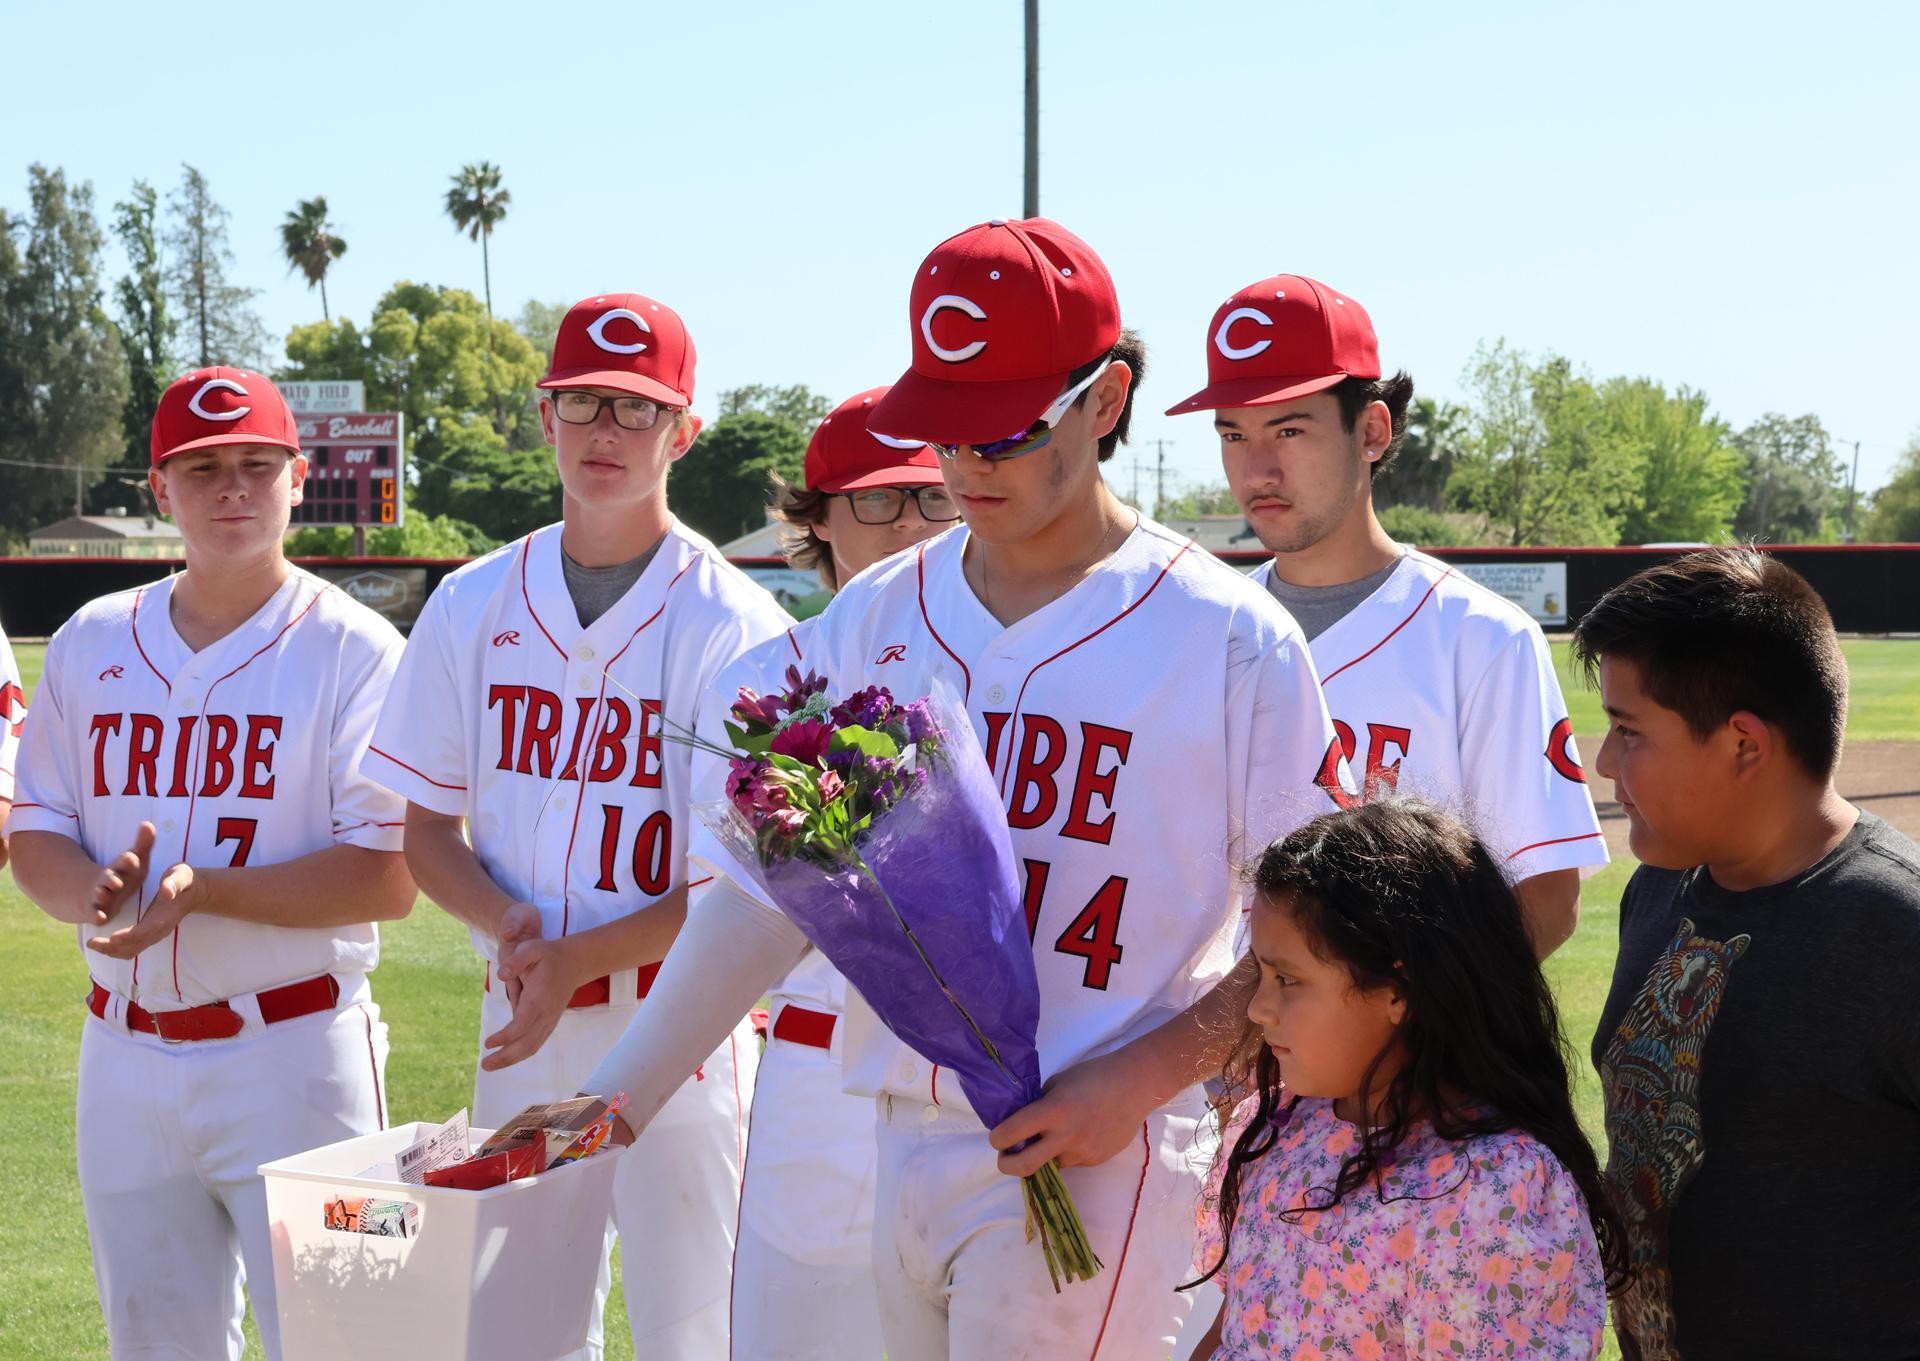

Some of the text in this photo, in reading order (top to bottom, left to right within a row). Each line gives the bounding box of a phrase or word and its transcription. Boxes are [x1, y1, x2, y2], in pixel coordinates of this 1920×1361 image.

[586, 308, 650, 355] C
[921, 295, 987, 362] C
[1214, 307, 1274, 360] C
[187, 378, 252, 422] C
[319, 385, 350, 399] FIELD
[328, 417, 395, 438] Baseball
[344, 449, 374, 464] OUT
[382, 479, 394, 499] 0
[382, 502, 394, 523] 0
[88, 712, 283, 800] TRIBE
[488, 684, 663, 789] TRIBE
[982, 711, 1133, 845] IBE
[215, 817, 258, 867] 7
[594, 803, 672, 897] 10
[1022, 858, 1129, 992] 14
